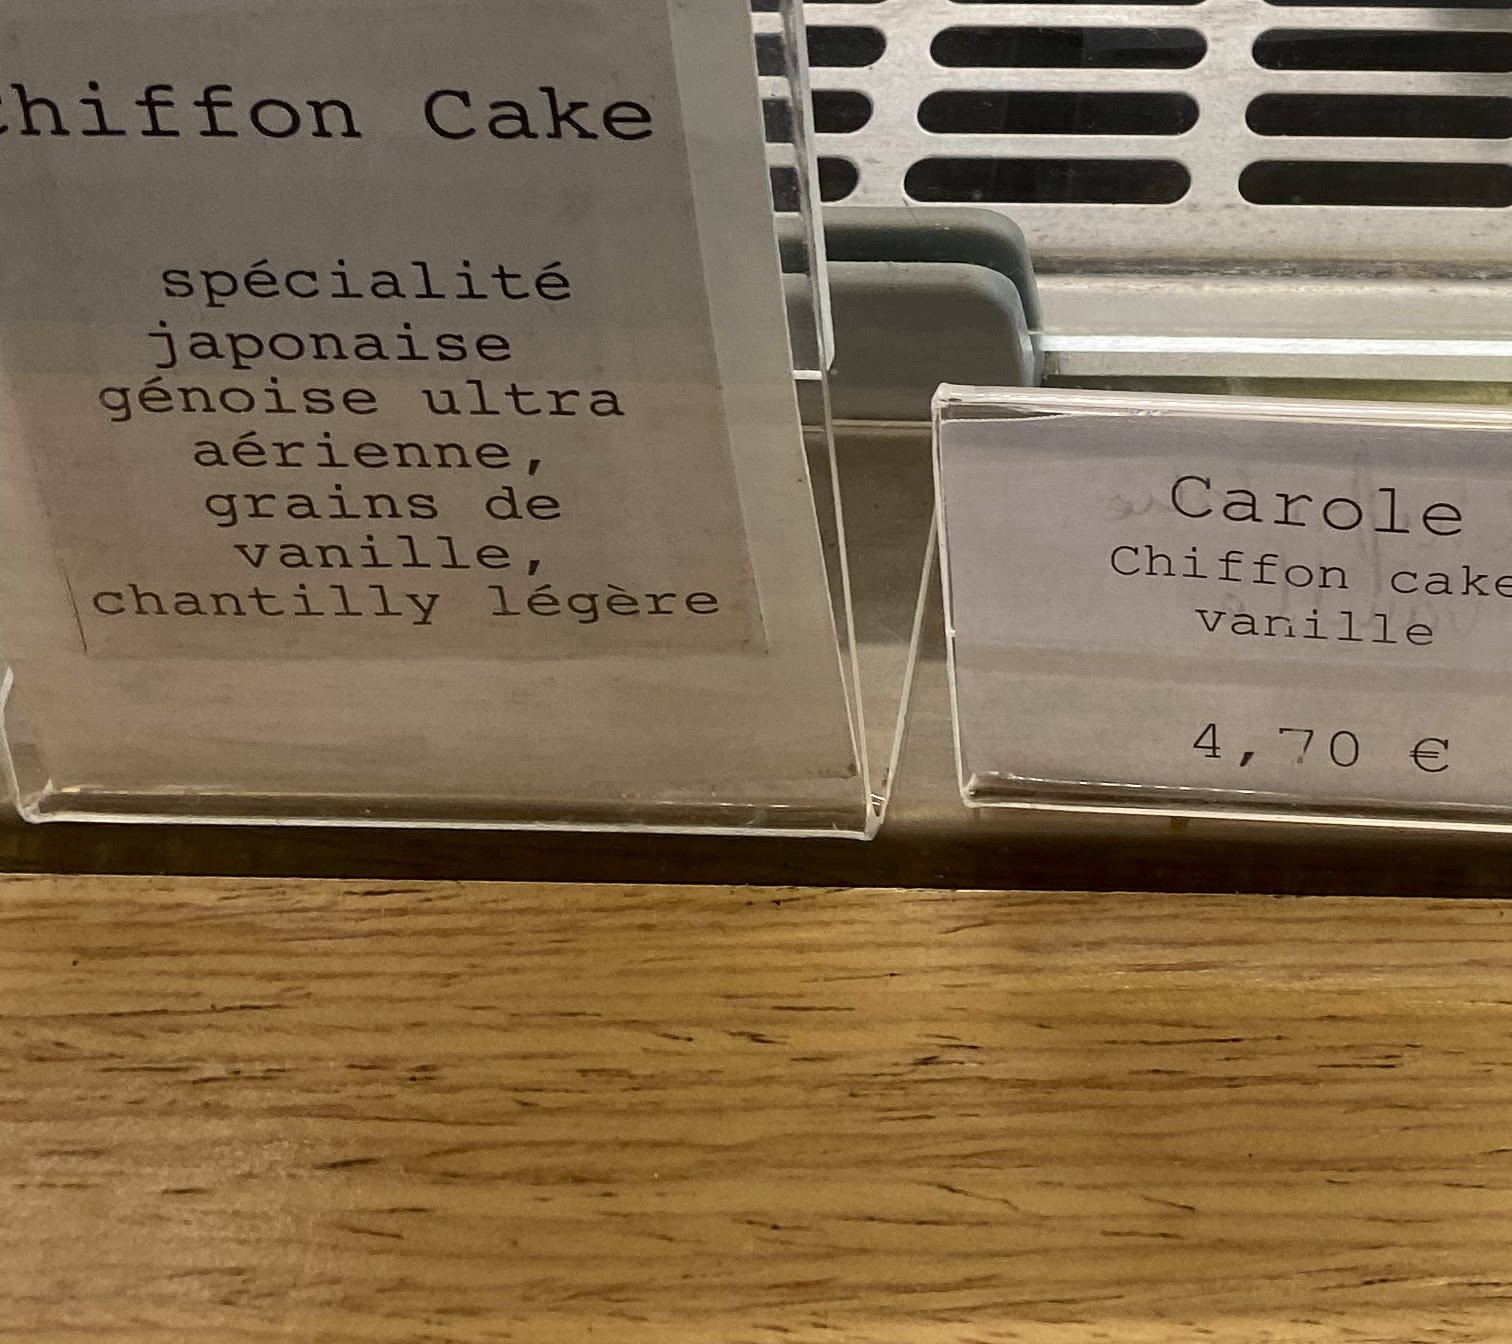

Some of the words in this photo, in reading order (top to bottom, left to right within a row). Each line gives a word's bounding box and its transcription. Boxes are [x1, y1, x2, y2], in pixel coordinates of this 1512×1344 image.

[0, 79, 363, 139] hiffon
[424, 85, 653, 142] Cake
[161, 257, 573, 308] spécialité
[147, 319, 513, 369] japonaise
[98, 376, 379, 424] génoise
[421, 378, 627, 418] ultra
[193, 429, 542, 478] aérienne,
[204, 483, 440, 529] grains
[485, 485, 562, 522] de
[1171, 475, 1464, 537] Carole
[233, 534, 542, 578] vanille,
[1110, 544, 1350, 591] Chiffon
[92, 583, 442, 627] chantilly
[487, 583, 721, 626] légère
[1194, 608, 1435, 647] vanille
[1192, 722, 1361, 769] 4,70
[1408, 737, 1450, 774] €
